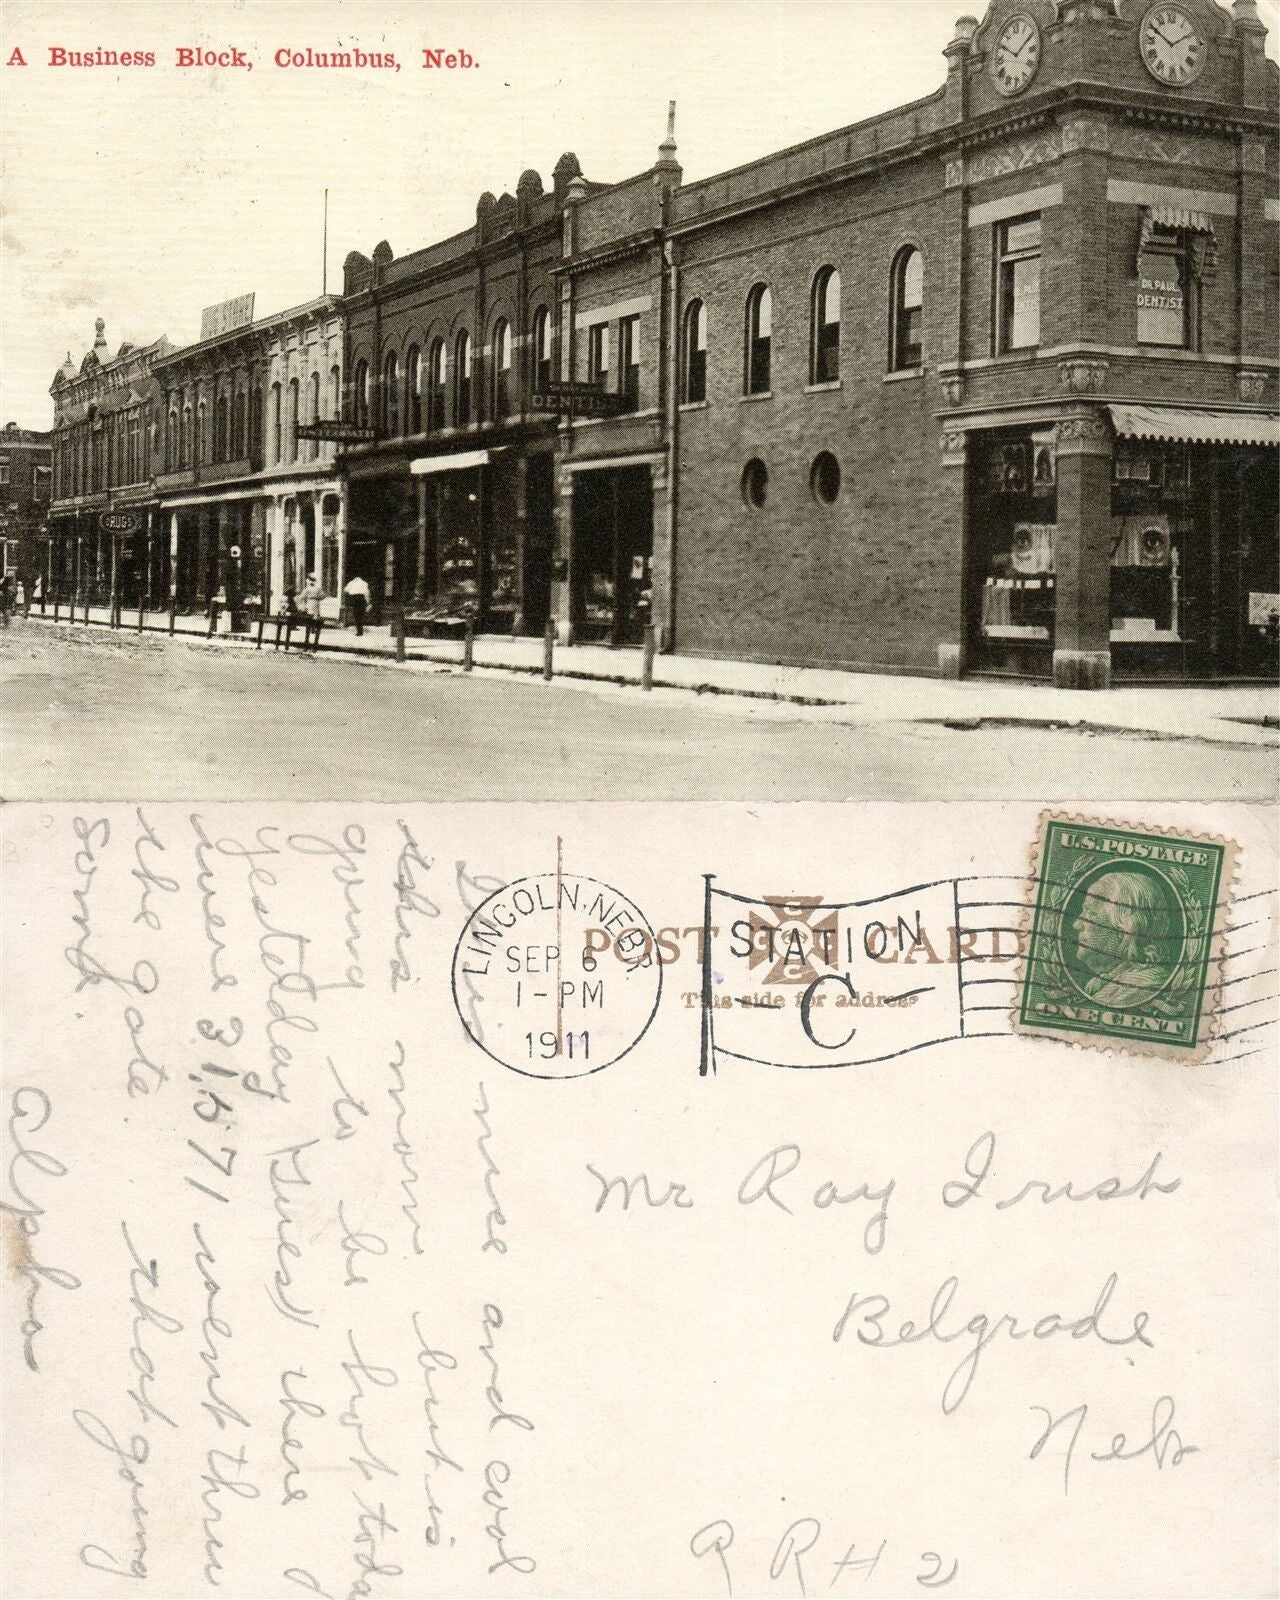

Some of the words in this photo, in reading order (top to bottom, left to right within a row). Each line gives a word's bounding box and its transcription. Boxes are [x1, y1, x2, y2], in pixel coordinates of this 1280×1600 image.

[1137, 294, 1183, 310] DENTIST
[131, 807, 181, 931] the
[190, 813, 239, 994] were
[279, 823, 367, 1004] going
[506, 945, 560, 973] SEP
[582, 945, 597, 973] 6
[583, 926, 720, 965] POST
[866, 925, 1027, 965] CARD
[730, 909, 922, 966] STATION
[525, 1030, 590, 1060] 1911
[740, 991, 787, 1009] side
[836, 990, 920, 1009] address
[1034, 1002, 1100, 1024] ONE
[1100, 1010, 1185, 1034] CENT
[326, 1056, 370, 1141] to
[474, 1082, 508, 1254] nice
[586, 1163, 694, 1214] Mr
[737, 1143, 897, 1256] Ray
[339, 1200, 388, 1286] be
[122, 1220, 185, 1430] that
[192, 1222, 252, 1432] went
[479, 1304, 536, 1433] and
[280, 1365, 326, 1506] there
[340, 1328, 399, 1482] hot
[412, 1311, 464, 1471] but
[1028, 1394, 1200, 1497] Neb
[72, 1408, 150, 1580] going
[201, 1444, 261, 1587] thru
[424, 1474, 456, 1549] is
[482, 1460, 537, 1574] cool
